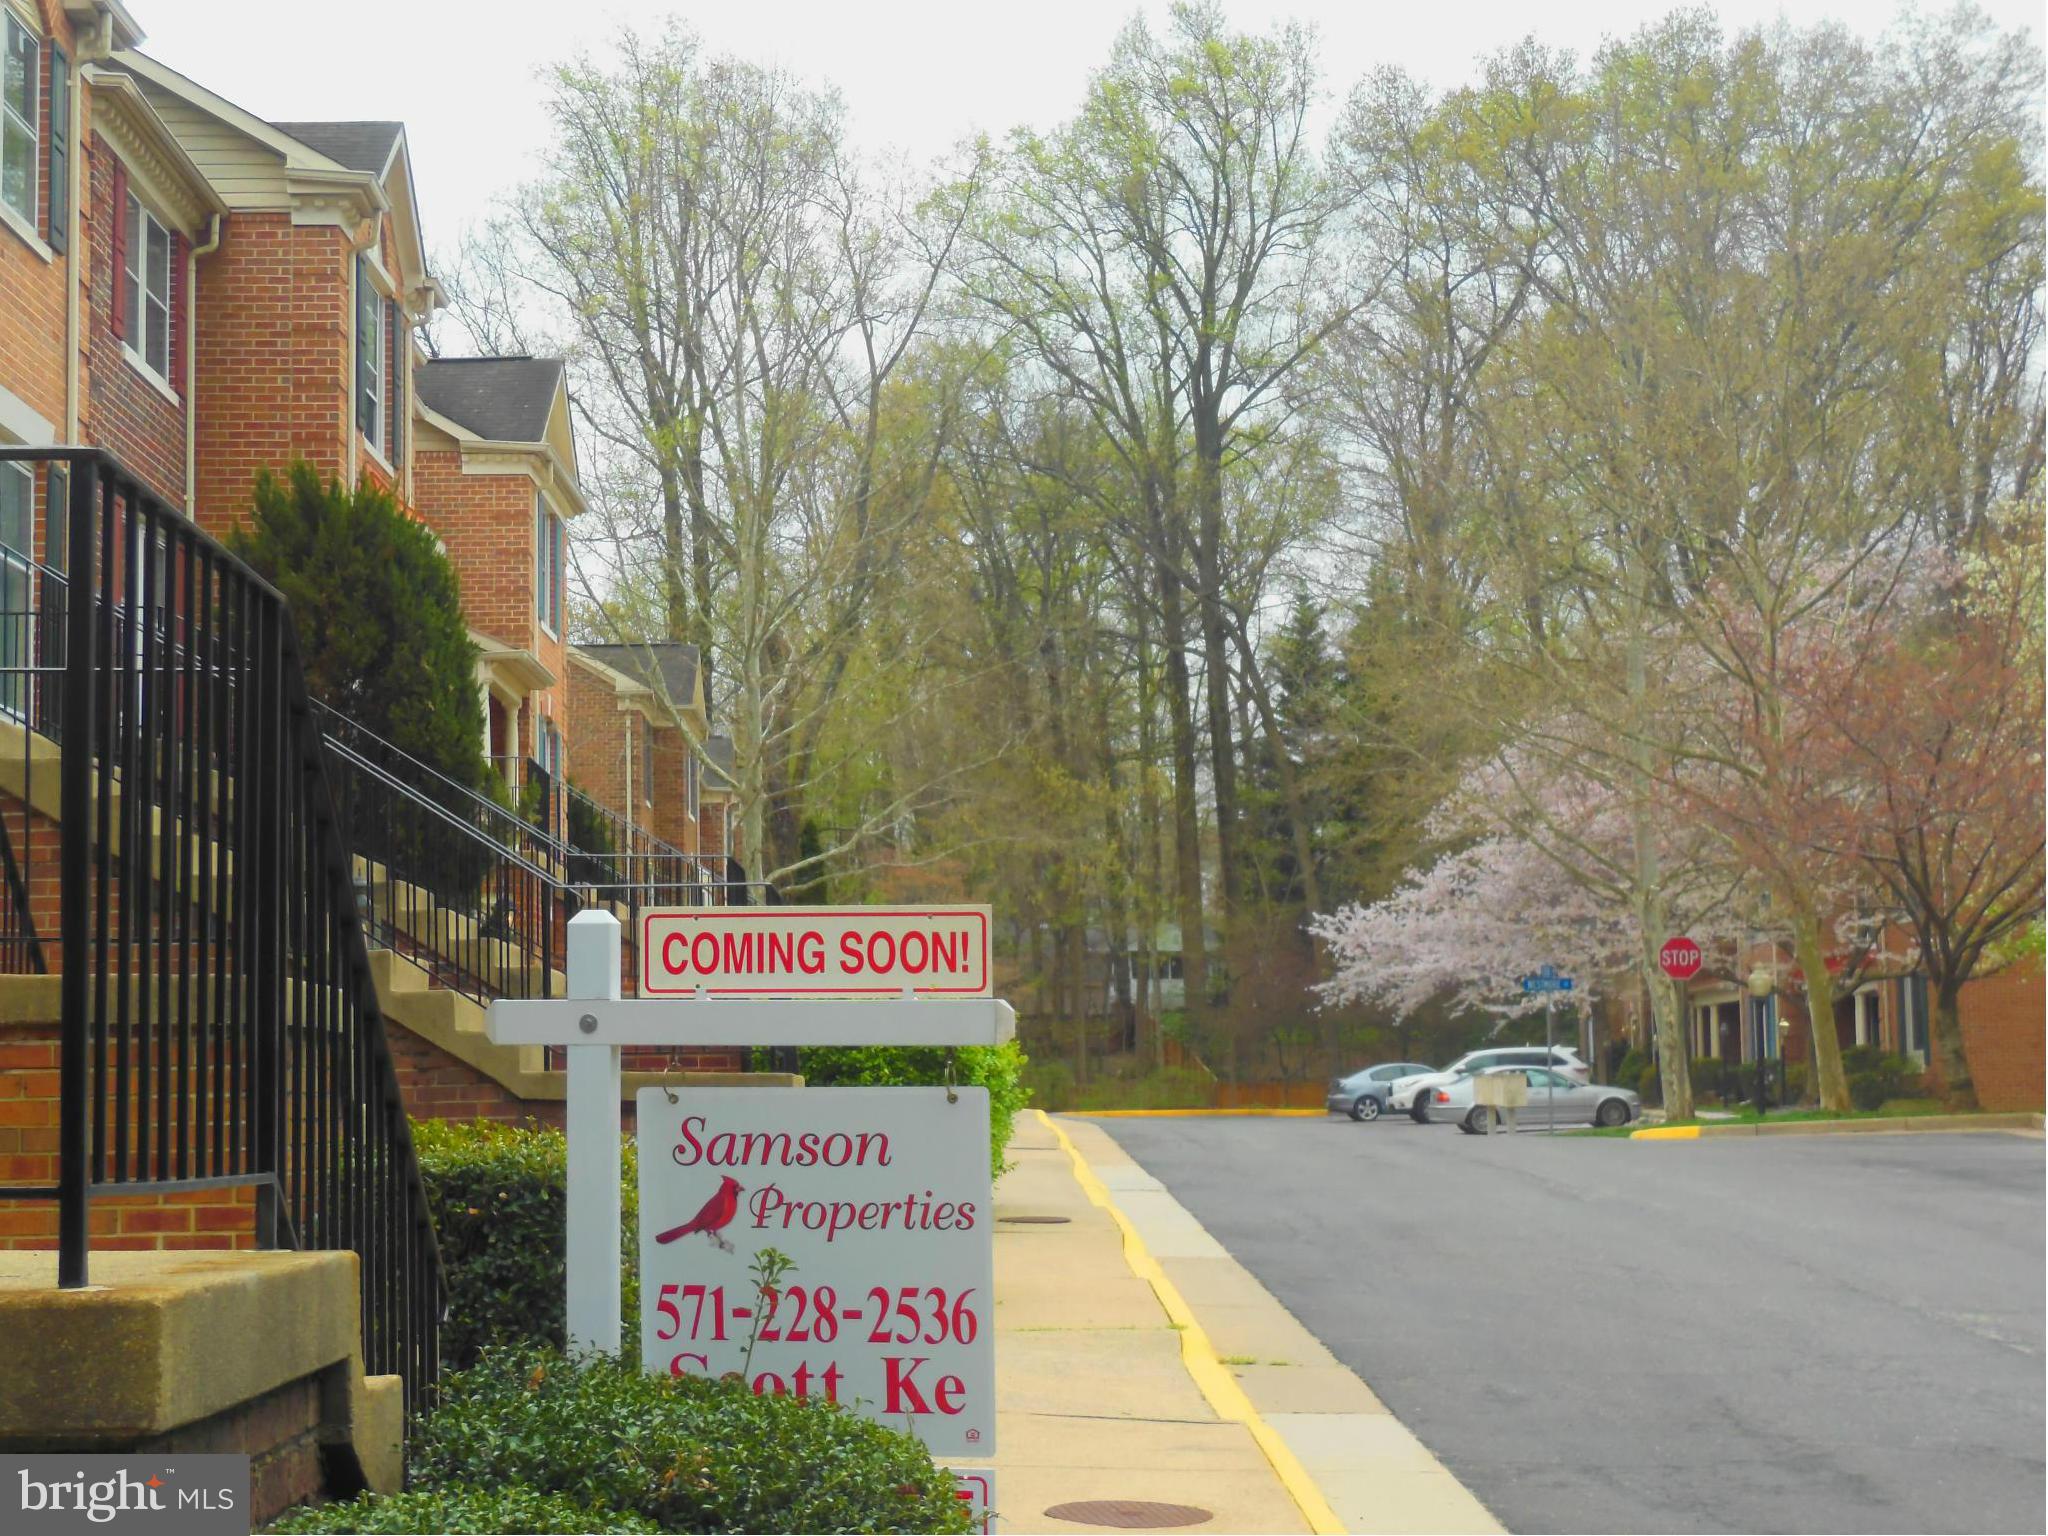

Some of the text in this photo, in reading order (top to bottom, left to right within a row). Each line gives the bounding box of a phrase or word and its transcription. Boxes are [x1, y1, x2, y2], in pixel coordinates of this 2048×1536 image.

[661, 930, 970, 975] COMING SOON!
[1662, 950, 1698, 966] STOP
[672, 1116, 892, 1167] Samson
[749, 1182, 975, 1242] Properties
[656, 1284, 978, 1345] 571-228-2536
[670, 1353, 967, 1414] ott Ke
